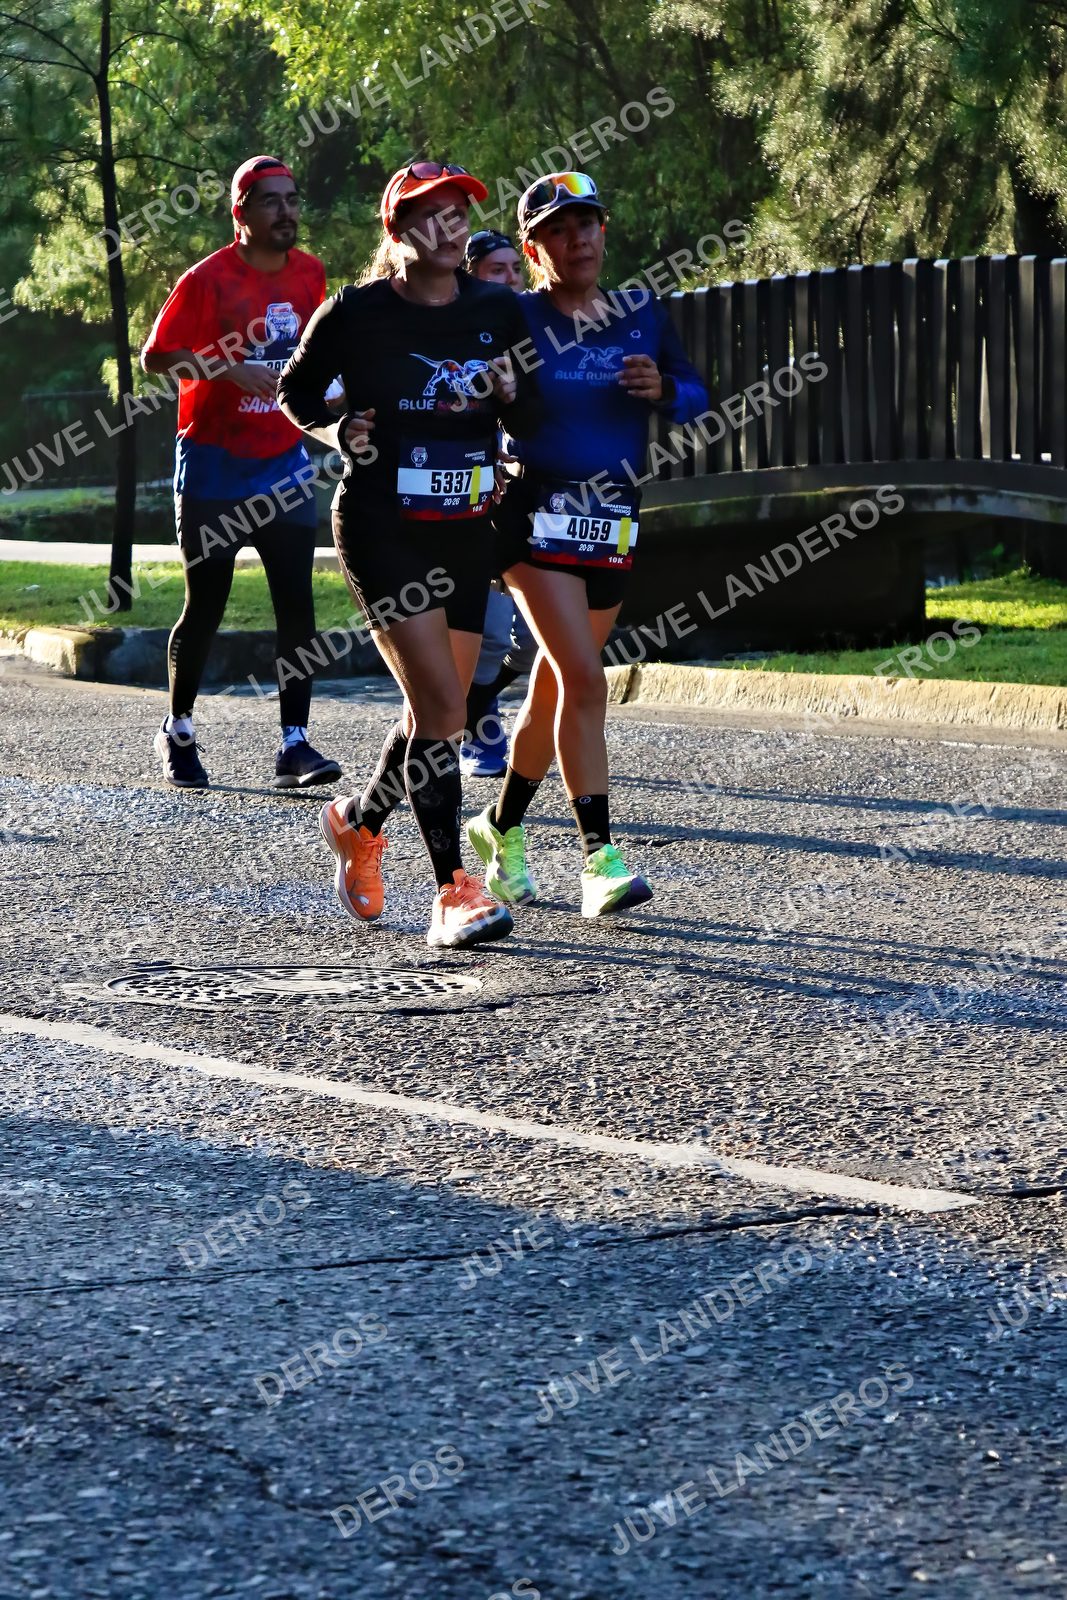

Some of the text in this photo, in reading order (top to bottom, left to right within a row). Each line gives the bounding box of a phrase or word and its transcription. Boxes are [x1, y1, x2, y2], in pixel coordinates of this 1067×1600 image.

[553, 370, 584, 380] BLUE
[399, 399, 436, 410] BLUE
[431, 471, 472, 493] 5337
[567, 518, 611, 542] 4059
